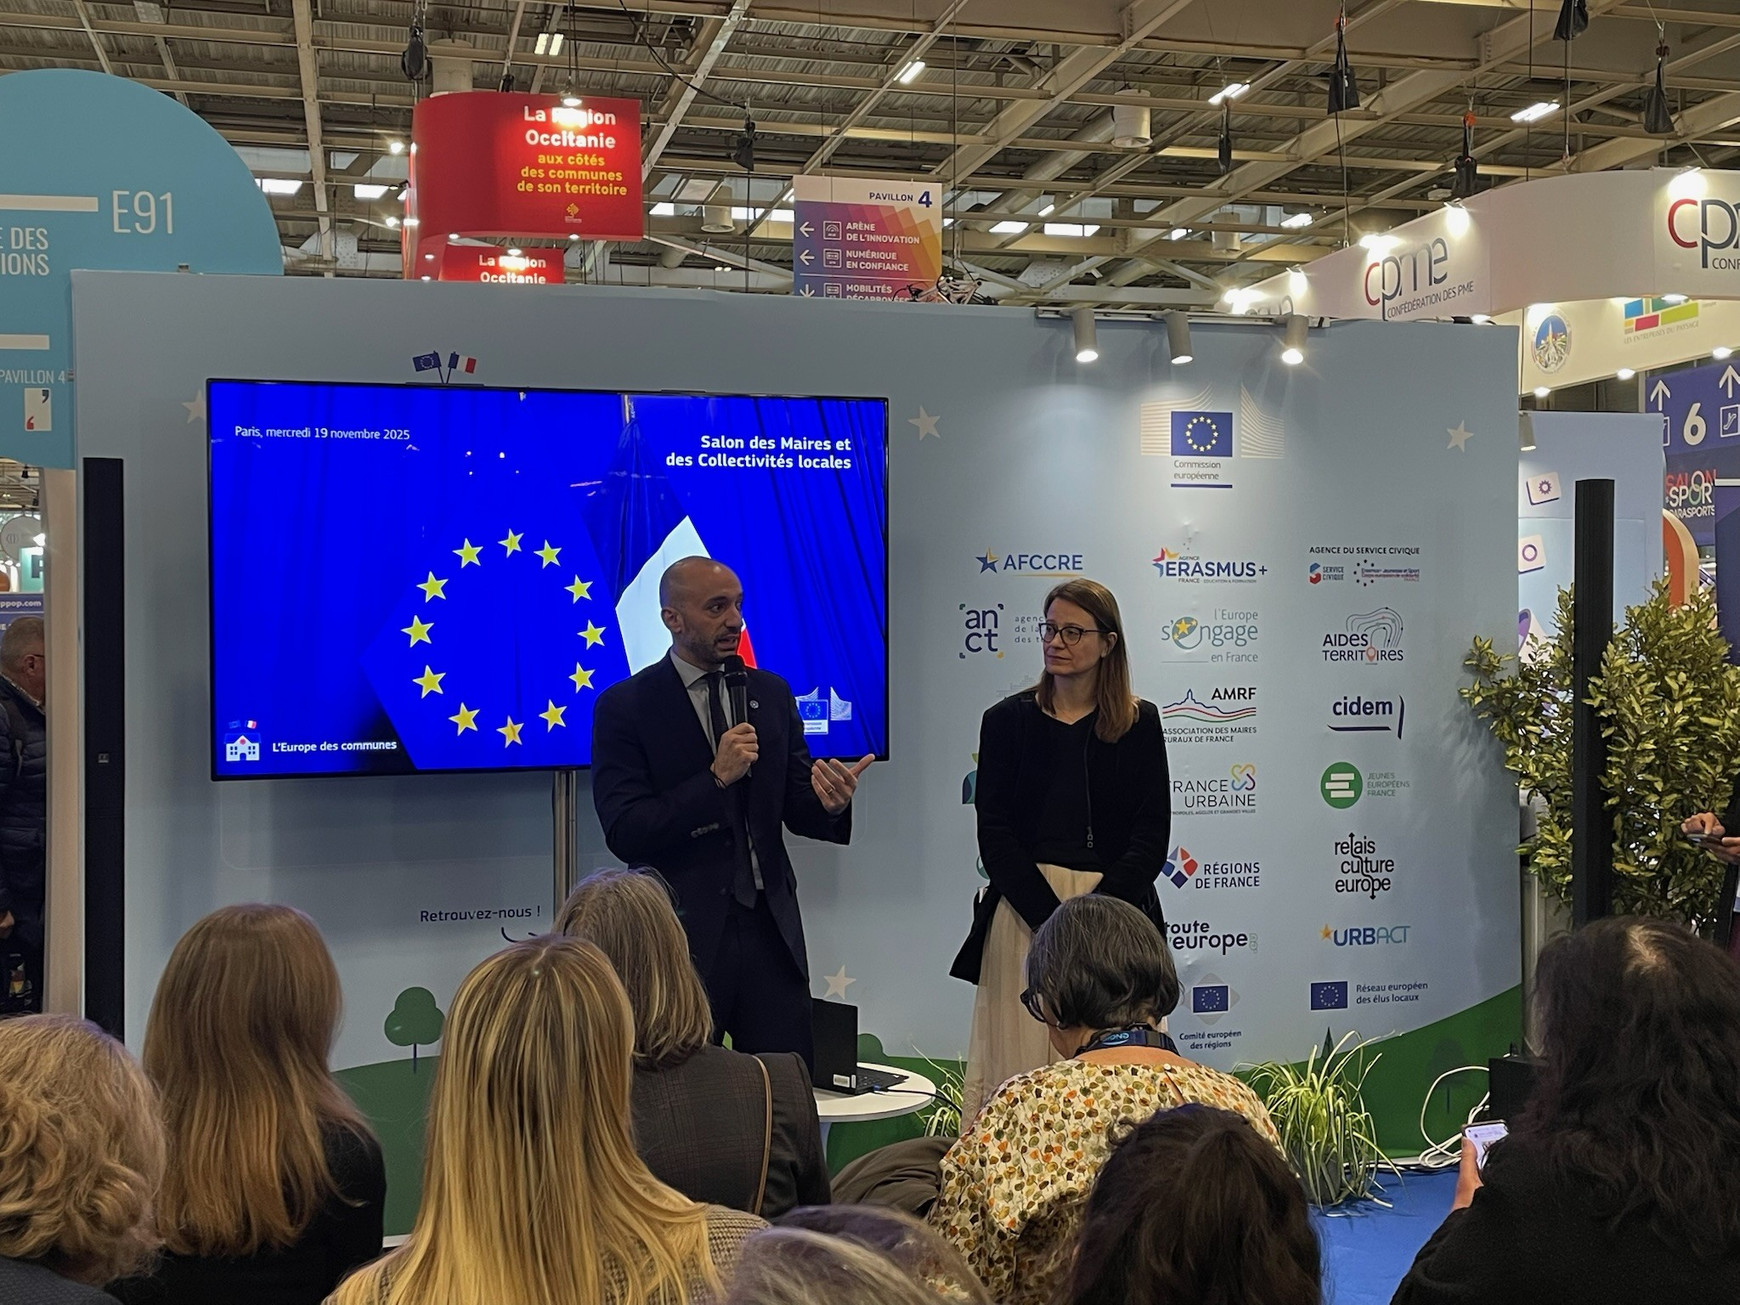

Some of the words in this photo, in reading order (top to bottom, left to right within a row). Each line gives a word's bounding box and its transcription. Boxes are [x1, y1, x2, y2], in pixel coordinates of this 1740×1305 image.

[524, 105, 546, 122] La
[525, 129, 616, 149] Occitanie
[538, 154, 564, 165] aux
[568, 153, 605, 166] côtés
[521, 166, 545, 178] des
[549, 169, 623, 181] communes
[517, 180, 534, 192] de
[537, 183, 561, 193] son
[565, 181, 628, 196] territoire
[869, 192, 914, 202] PAVILLON
[918, 191, 933, 208] 4
[112, 190, 173, 234] E91
[846, 221, 876, 231] ARÈNE
[10, 227, 49, 250] DES
[846, 233, 858, 241] DE
[859, 234, 920, 244] L'INNOVATION
[479, 254, 496, 267] La
[846, 249, 897, 260] NUMÉRIQUE
[846, 261, 858, 269] EN
[859, 262, 909, 271] CONFIANCE
[480, 271, 546, 285] Occitanie
[1365, 237, 1448, 321] cpme
[846, 284, 892, 294] MOBILITÉS
[1387, 292, 1441, 318] CONFÉDÉRATION
[1443, 287, 1457, 301] DES
[1457, 281, 1474, 296] PME
[57, 370, 66, 384] 4
[1683, 403, 1707, 445] 6
[235, 426, 263, 438] Paris,
[266, 427, 311, 438] mercredi
[314, 427, 328, 438] 19
[330, 428, 380, 439] novembre
[383, 429, 410, 440] 2025
[701, 435, 744, 449] Salon
[749, 436, 775, 449] des
[781, 437, 832, 450] Maires
[836, 438, 851, 451] et
[666, 452, 693, 466] des
[698, 453, 793, 468] Collectivités
[798, 455, 851, 469] locales
[1174, 460, 1221, 469] Commission
[1174, 470, 1219, 481] européenne
[1669, 482, 1713, 507] SPOR
[1389, 547, 1420, 555] CIVIQUE
[1003, 554, 1083, 570] AFCCRE
[1165, 561, 1267, 577] ERASMUS+
[965, 610, 998, 629] an
[1015, 616, 1044, 624] agenc
[1214, 608, 1258, 623] l'Europe
[965, 629, 998, 652] ct
[1211, 654, 1223, 663] en
[1226, 652, 1258, 663] France
[1211, 687, 1257, 700] AMRF
[1332, 696, 1393, 716] cidem
[1163, 727, 1213, 735] ASSOCIATION
[272, 742, 317, 753] L'Europe
[320, 741, 338, 751] des
[341, 741, 397, 750] communes
[1367, 772, 1395, 780] JEUNES
[1171, 779, 1229, 793] RANCE
[1367, 780, 1410, 788] EUROPÉENS
[1367, 789, 1396, 797] FRANCE
[1184, 794, 1256, 808] URBAINE
[1335, 832, 1376, 857] relais
[1204, 862, 1260, 875] RÉGIONS
[1341, 857, 1394, 874] culture
[1195, 878, 1210, 889] DE
[1214, 876, 1260, 888] FRANCE
[1335, 877, 1391, 899] europe
[420, 907, 532, 922] Retrouvez-nous
[1164, 920, 1210, 934] toute
[1333, 925, 1411, 946] URBACT
[1356, 984, 1386, 992] Réseau
[1388, 982, 1428, 992] européen
[1356, 996, 1371, 1004] des
[1373, 995, 1390, 1003] élus
[1391, 994, 1419, 1002] locaux
[1179, 1031, 1205, 1040] Comité
[1207, 1030, 1242, 1039] européen
[1190, 1041, 1203, 1050] des
[1204, 1041, 1232, 1050] régions
